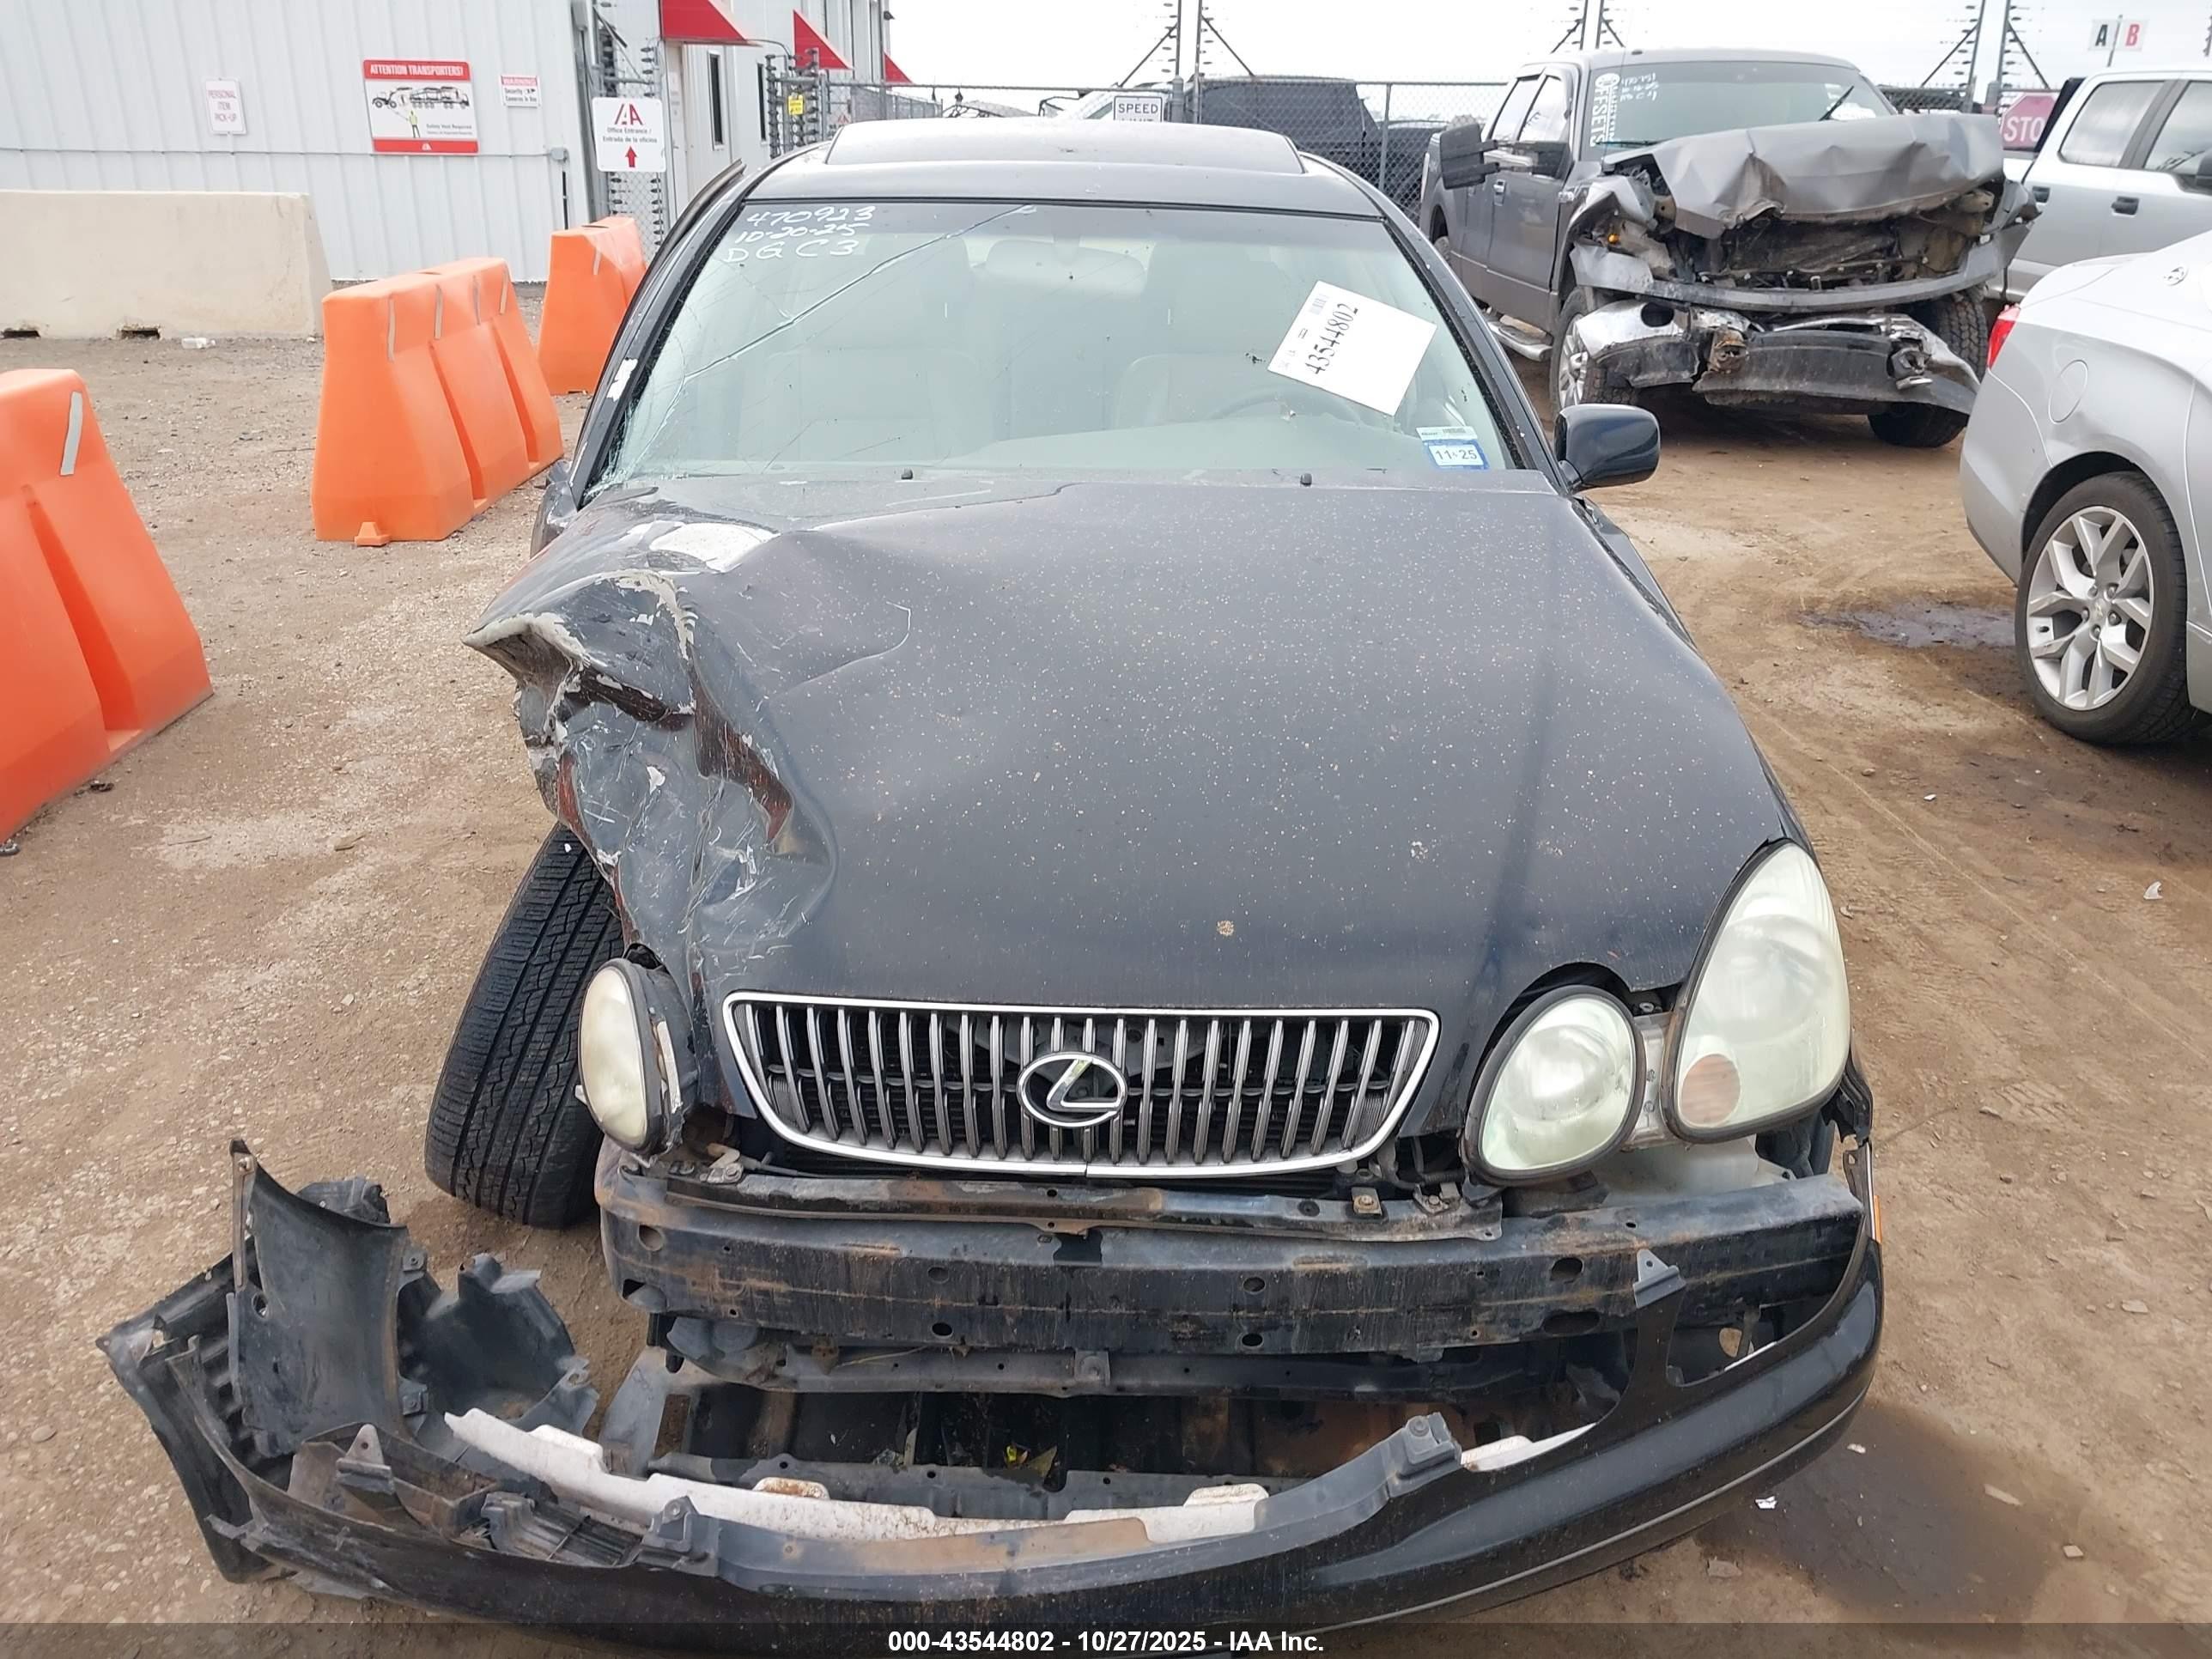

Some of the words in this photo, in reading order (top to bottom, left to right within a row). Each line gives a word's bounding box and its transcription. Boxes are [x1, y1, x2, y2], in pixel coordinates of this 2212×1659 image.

[2095, 24, 2108, 46] A
[2125, 23, 2140, 46] B
[370, 64, 407, 76] ATTENTION
[1118, 103, 1158, 114] SPEED
[2003, 116, 2047, 142] STO
[746, 205, 876, 227] 470923
[735, 222, 871, 244] 10-20-25
[1304, 302, 1359, 375] 43544802
